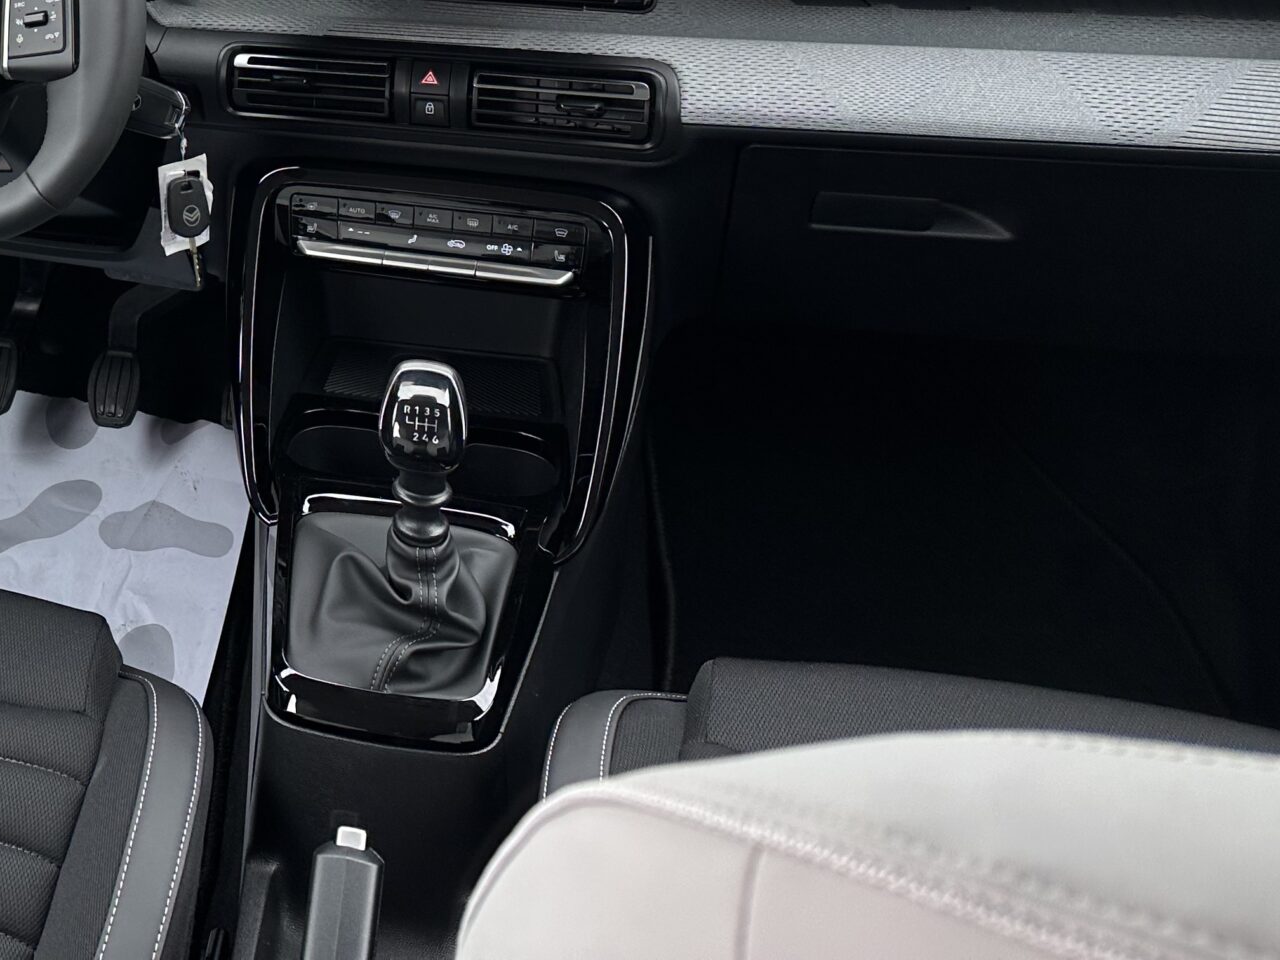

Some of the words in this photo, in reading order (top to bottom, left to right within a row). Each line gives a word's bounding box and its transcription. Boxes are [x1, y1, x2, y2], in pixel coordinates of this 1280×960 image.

[349, 206, 366, 215] AUTO
[486, 244, 499, 252] OFF
[403, 405, 411, 414] R
[424, 407, 430, 416] 3
[434, 409, 441, 418] 5
[412, 432, 419, 442] 2
[422, 433, 429, 442] 4
[432, 435, 439, 445] 6
